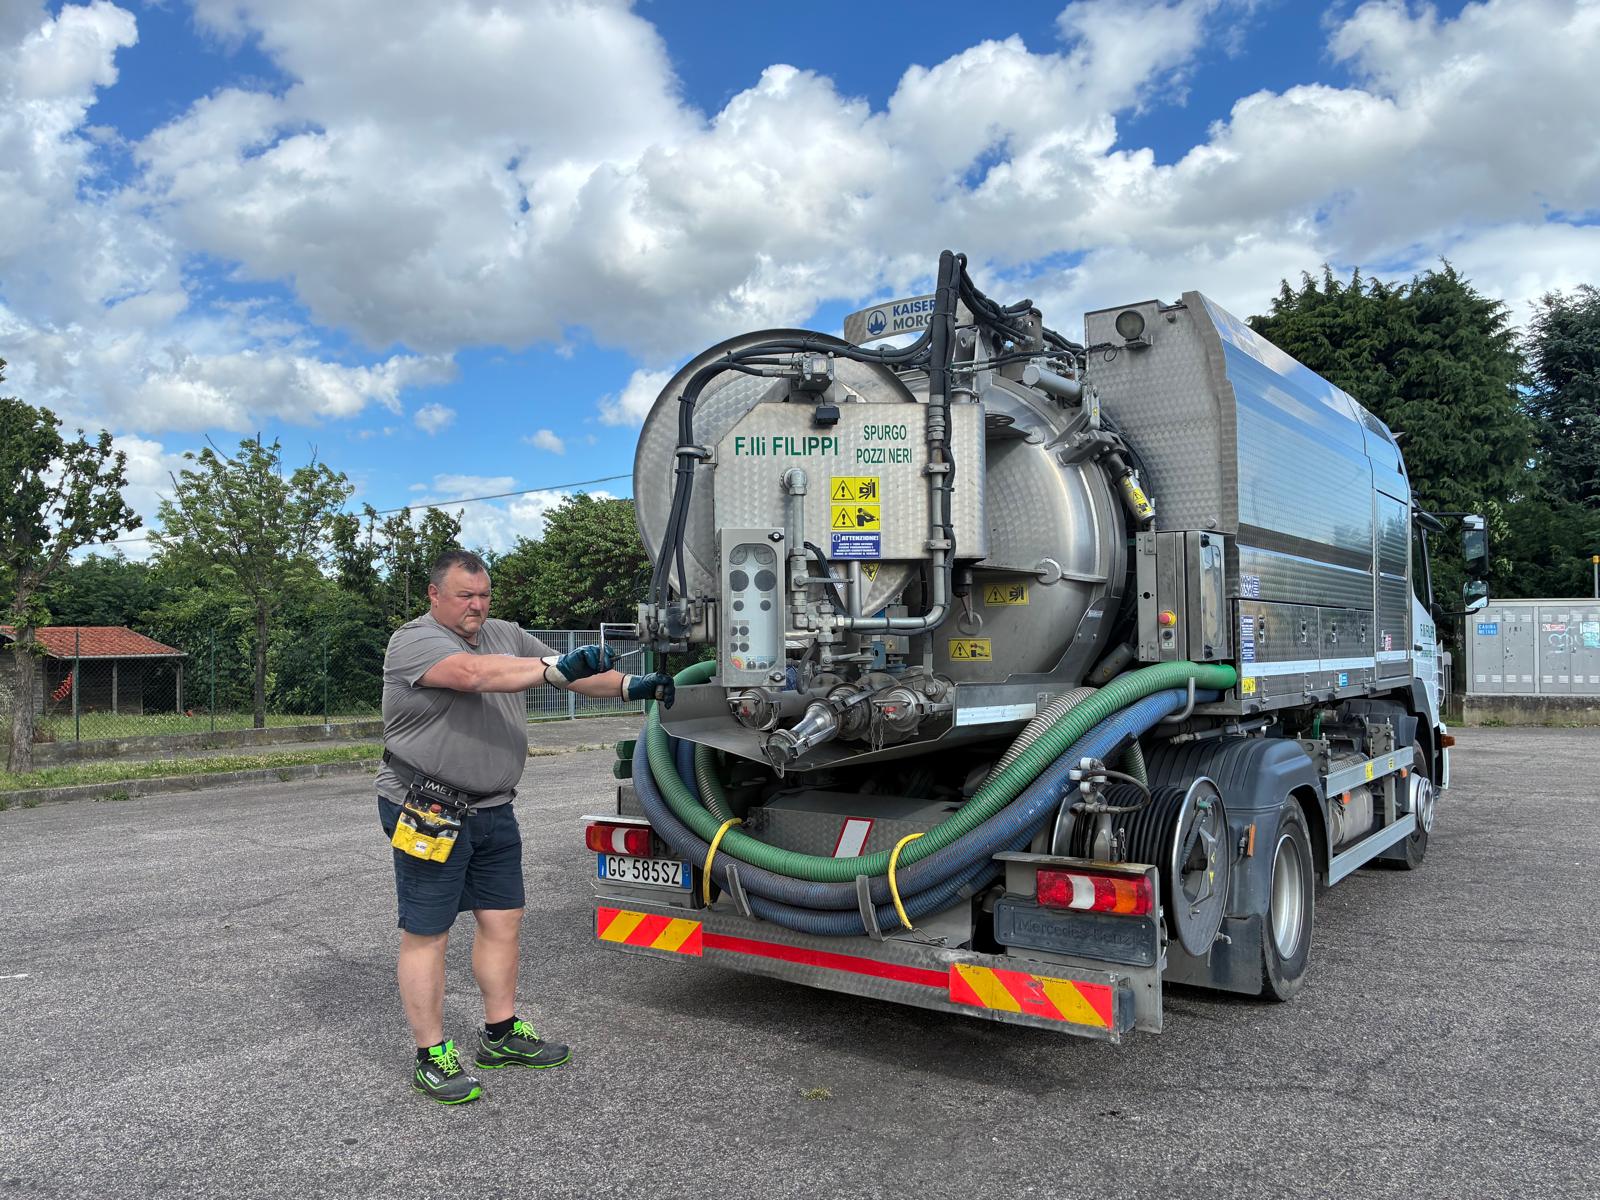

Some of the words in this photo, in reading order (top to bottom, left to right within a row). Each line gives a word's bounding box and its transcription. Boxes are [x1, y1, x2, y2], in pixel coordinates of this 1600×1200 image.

[893, 299, 936, 316] KAISER
[863, 425, 907, 441] SPURGO
[735, 436, 766, 456] F.lli
[773, 436, 839, 456] FILIPPI
[856, 448, 886, 464] POZZI
[888, 448, 912, 464] NERI
[608, 857, 626, 878] GG
[632, 858, 680, 885] 585SZ
